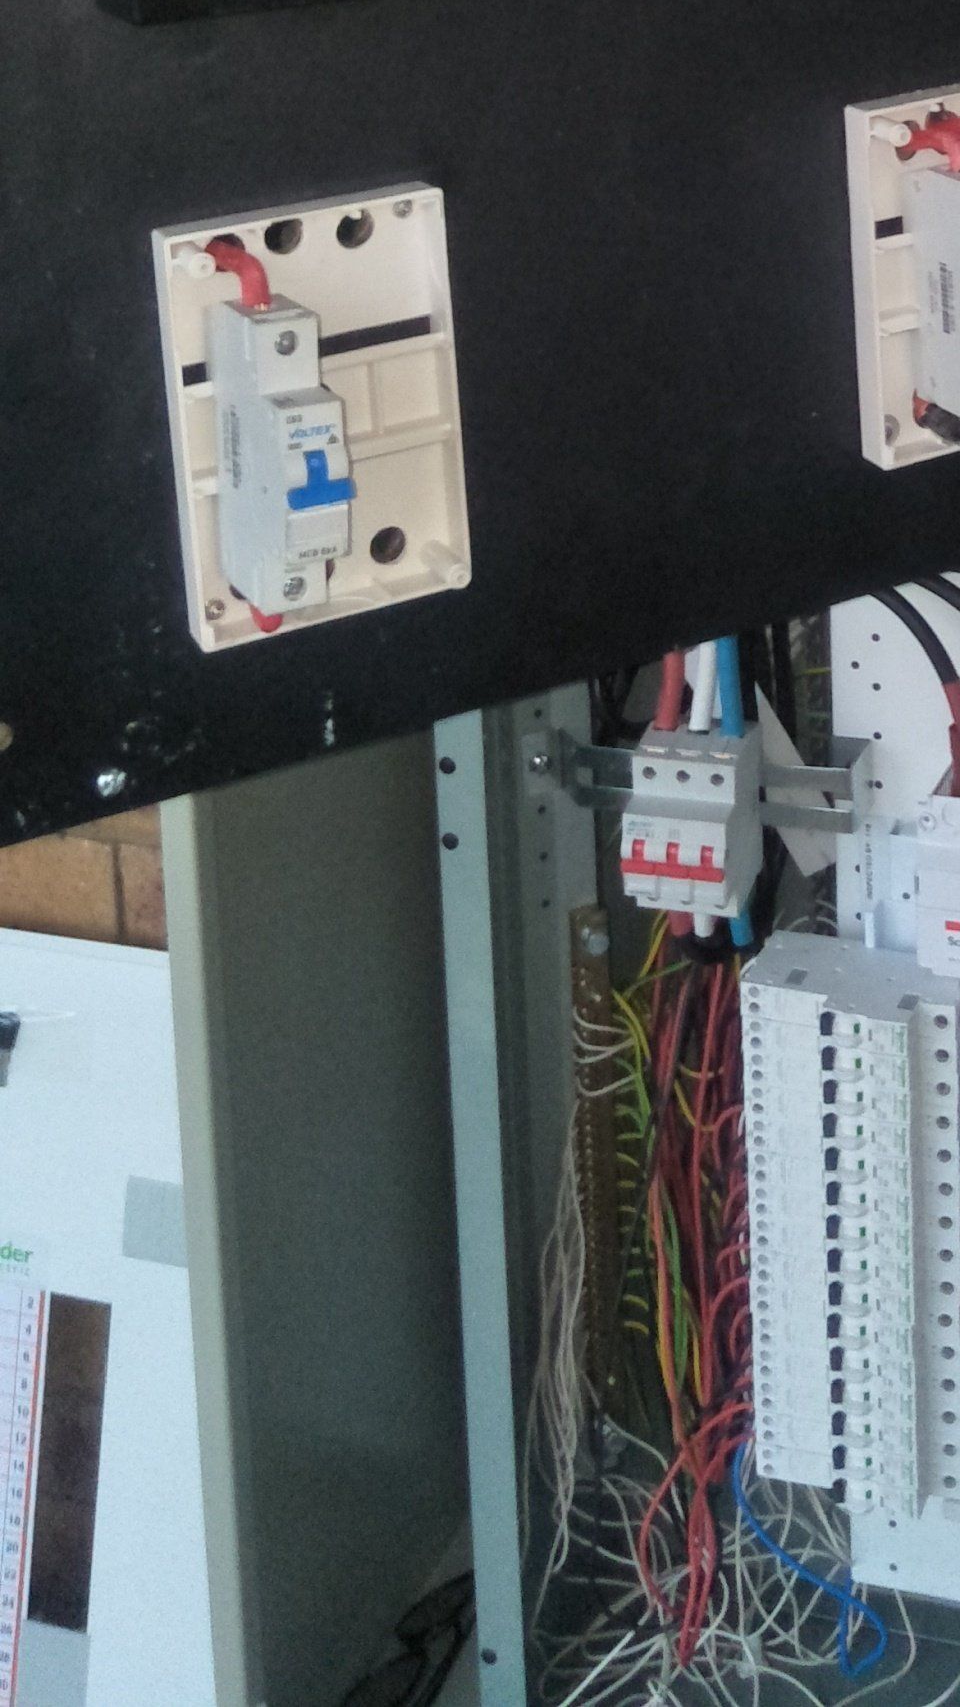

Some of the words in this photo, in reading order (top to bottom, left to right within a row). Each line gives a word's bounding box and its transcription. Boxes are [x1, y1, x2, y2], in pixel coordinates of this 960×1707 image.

[25, 1323, 32, 1336] 4
[17, 1403, 30, 1418] 10
[15, 1430, 27, 1444] 12
[13, 1457, 25, 1472] 14
